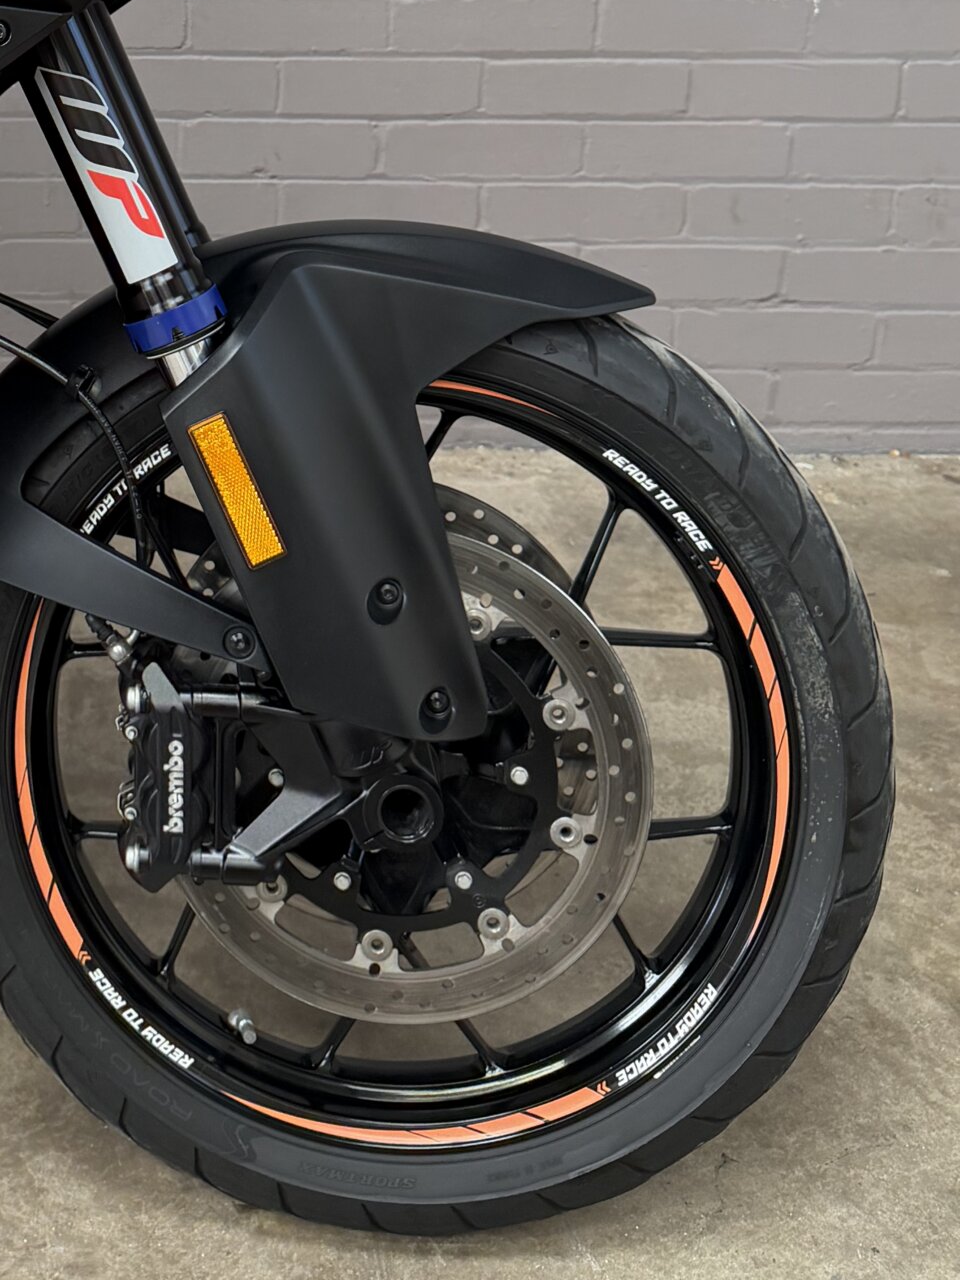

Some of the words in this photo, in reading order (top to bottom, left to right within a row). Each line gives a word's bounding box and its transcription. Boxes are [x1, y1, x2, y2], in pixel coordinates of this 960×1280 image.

[80, 493, 115, 535] EADY
[132, 443, 171, 480] RACE
[602, 448, 659, 492] READY
[655, 489, 679, 511] TO
[672, 510, 714, 553] RACE
[163, 739, 184, 834] brembo
[87, 967, 127, 1010] RACE
[675, 982, 719, 1038] READY
[121, 1007, 145, 1032] TO
[141, 1025, 195, 1069] READY
[656, 1031, 679, 1056] TO
[615, 1048, 656, 1088] RACE
